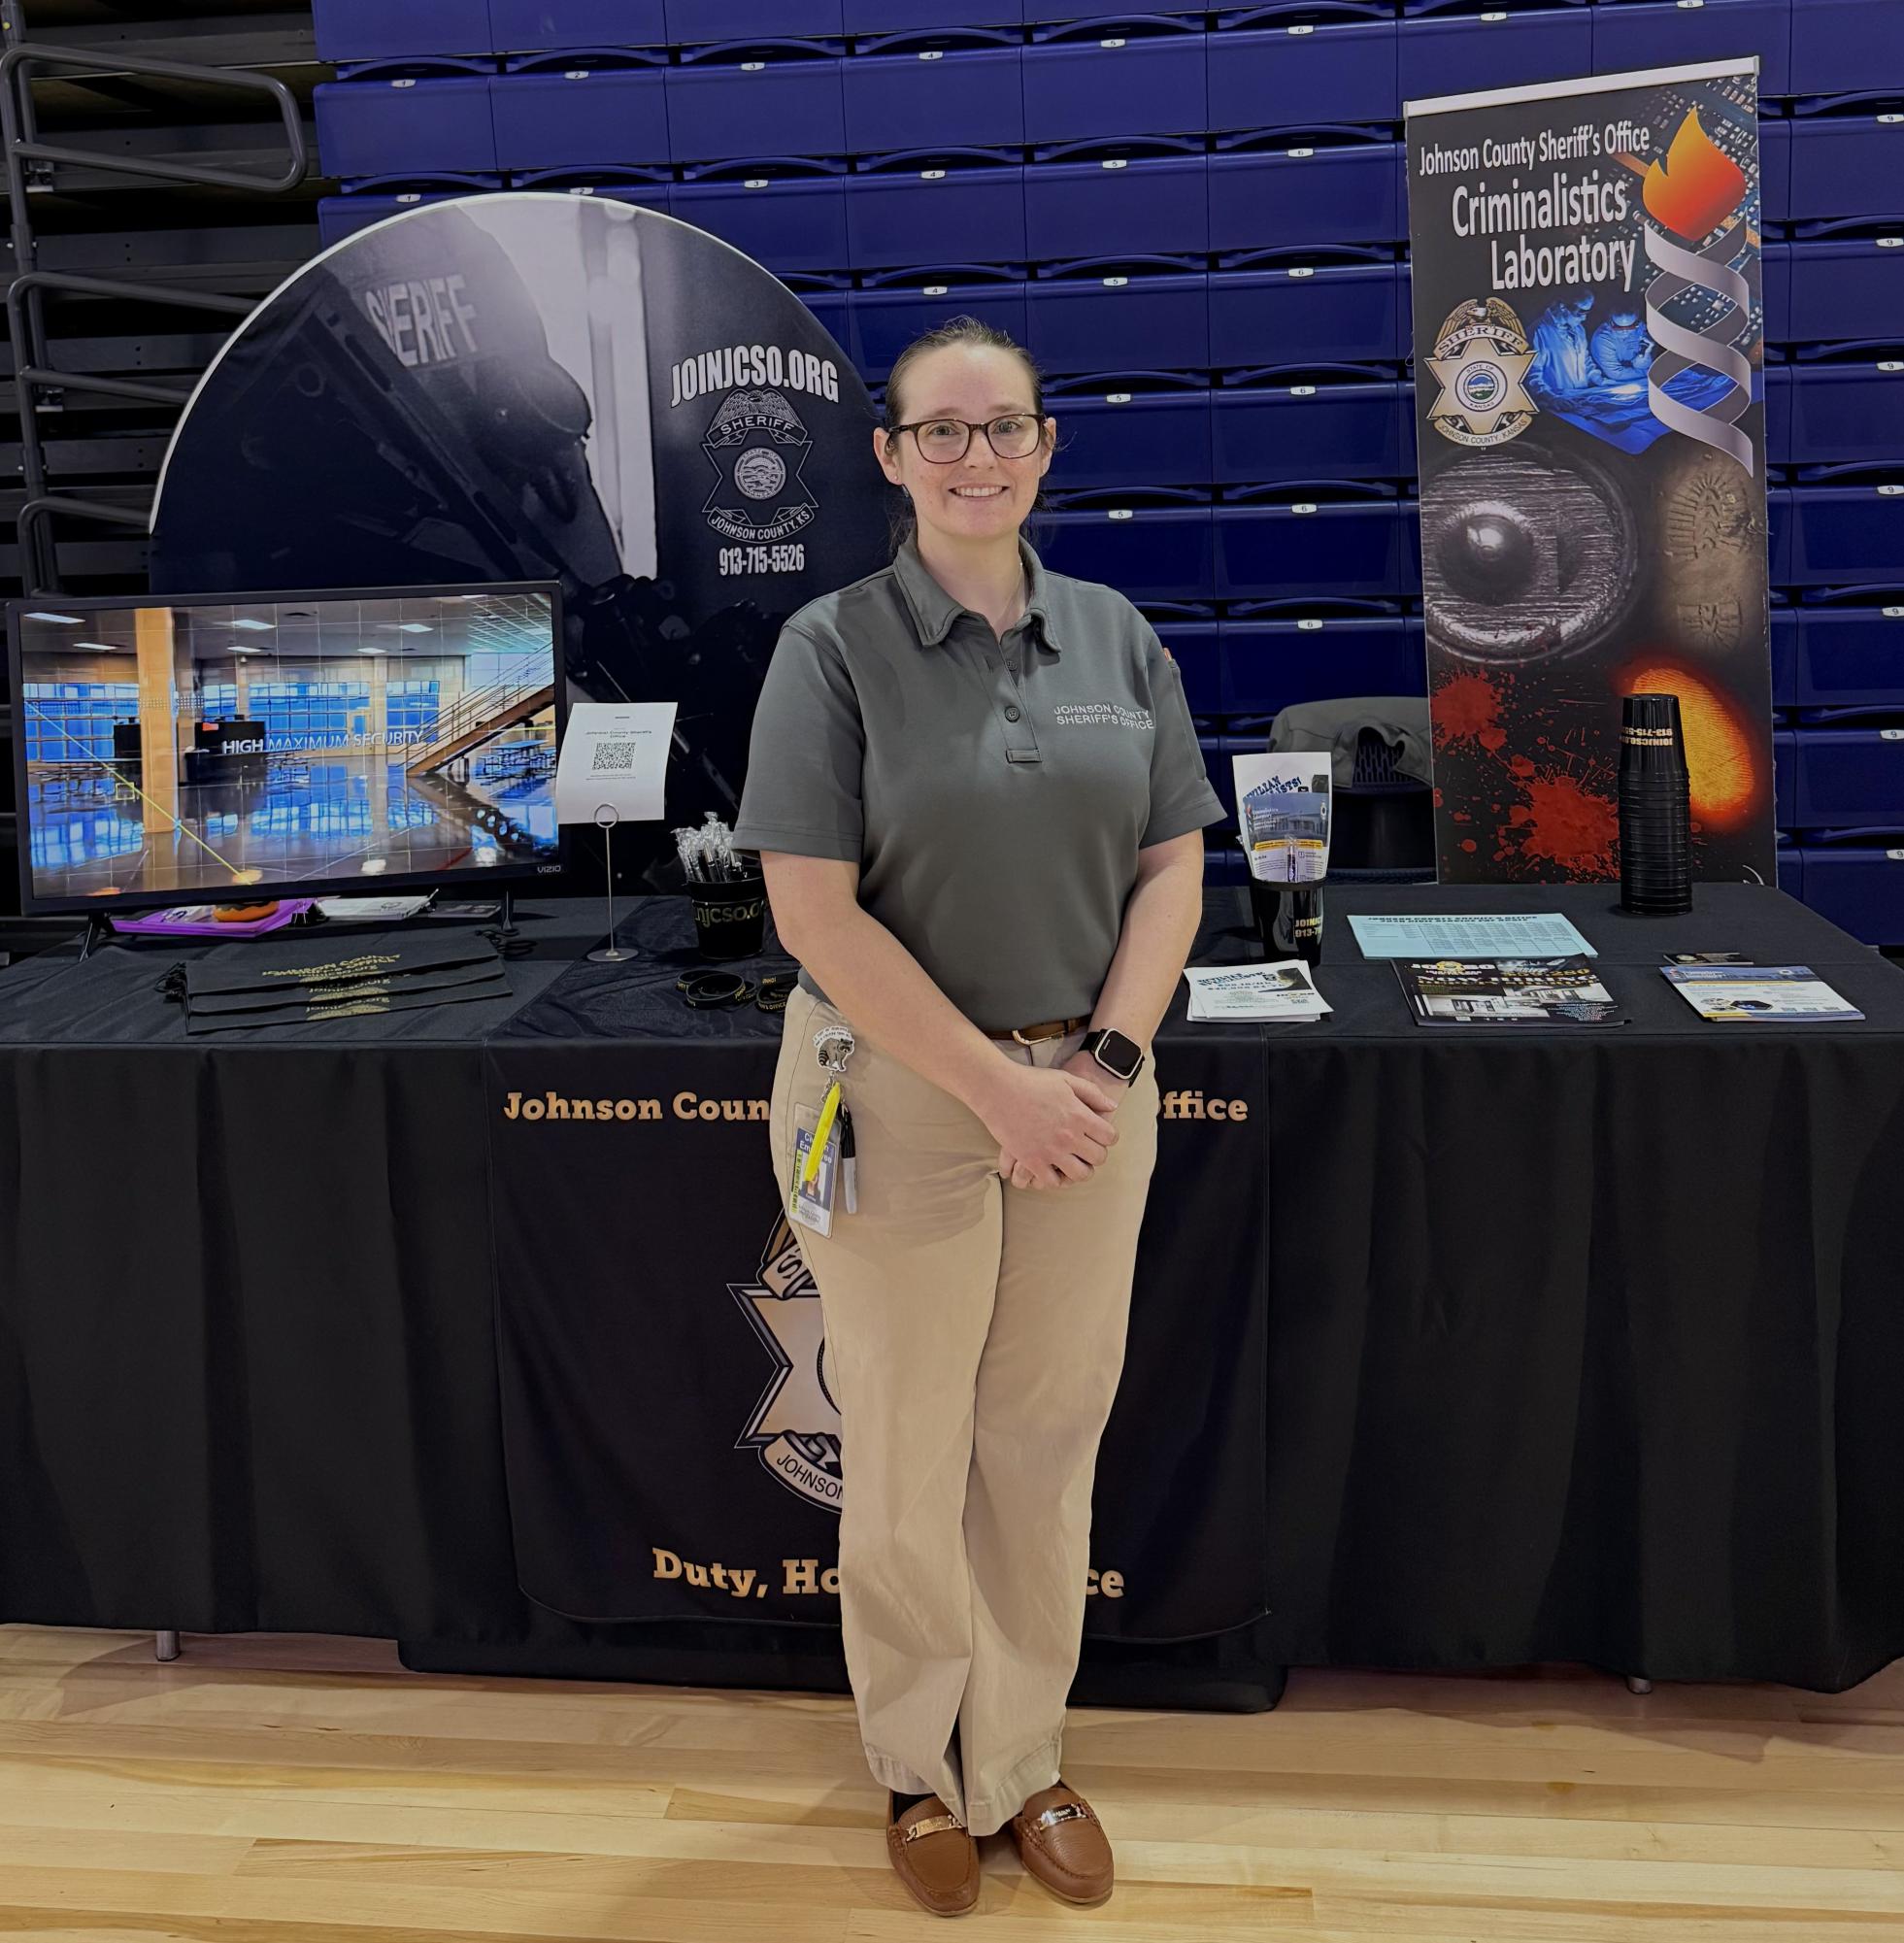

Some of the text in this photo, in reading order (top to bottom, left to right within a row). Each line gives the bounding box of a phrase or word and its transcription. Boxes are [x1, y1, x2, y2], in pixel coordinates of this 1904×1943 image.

[1419, 120, 1650, 176] Johnson County Sheriff's Office
[1453, 169, 1627, 237] Criminalistics
[1491, 234, 1635, 292] Laboratory
[1438, 326, 1522, 352] SHERIFF
[671, 345, 839, 408] JOINJCSO.ORG
[720, 416, 795, 435] SHERIFF
[1440, 424, 1469, 443] JOHNSON
[1502, 419, 1527, 438] KANSAS
[712, 516, 755, 539] JOHNSON
[795, 510, 810, 525] KS
[719, 544, 805, 576] 913-715-5526
[1054, 703, 1150, 720] JOHNSON COUNTY
[1056, 714, 1154, 730] SHERIFF'S OFFICE
[222, 729, 425, 754] HIGH MAXIMUM SECURITY
[537, 865, 561, 874] VIZIO
[503, 1090, 1249, 1121] Johnson Coun ffice
[651, 1547, 768, 1598] Duty,
